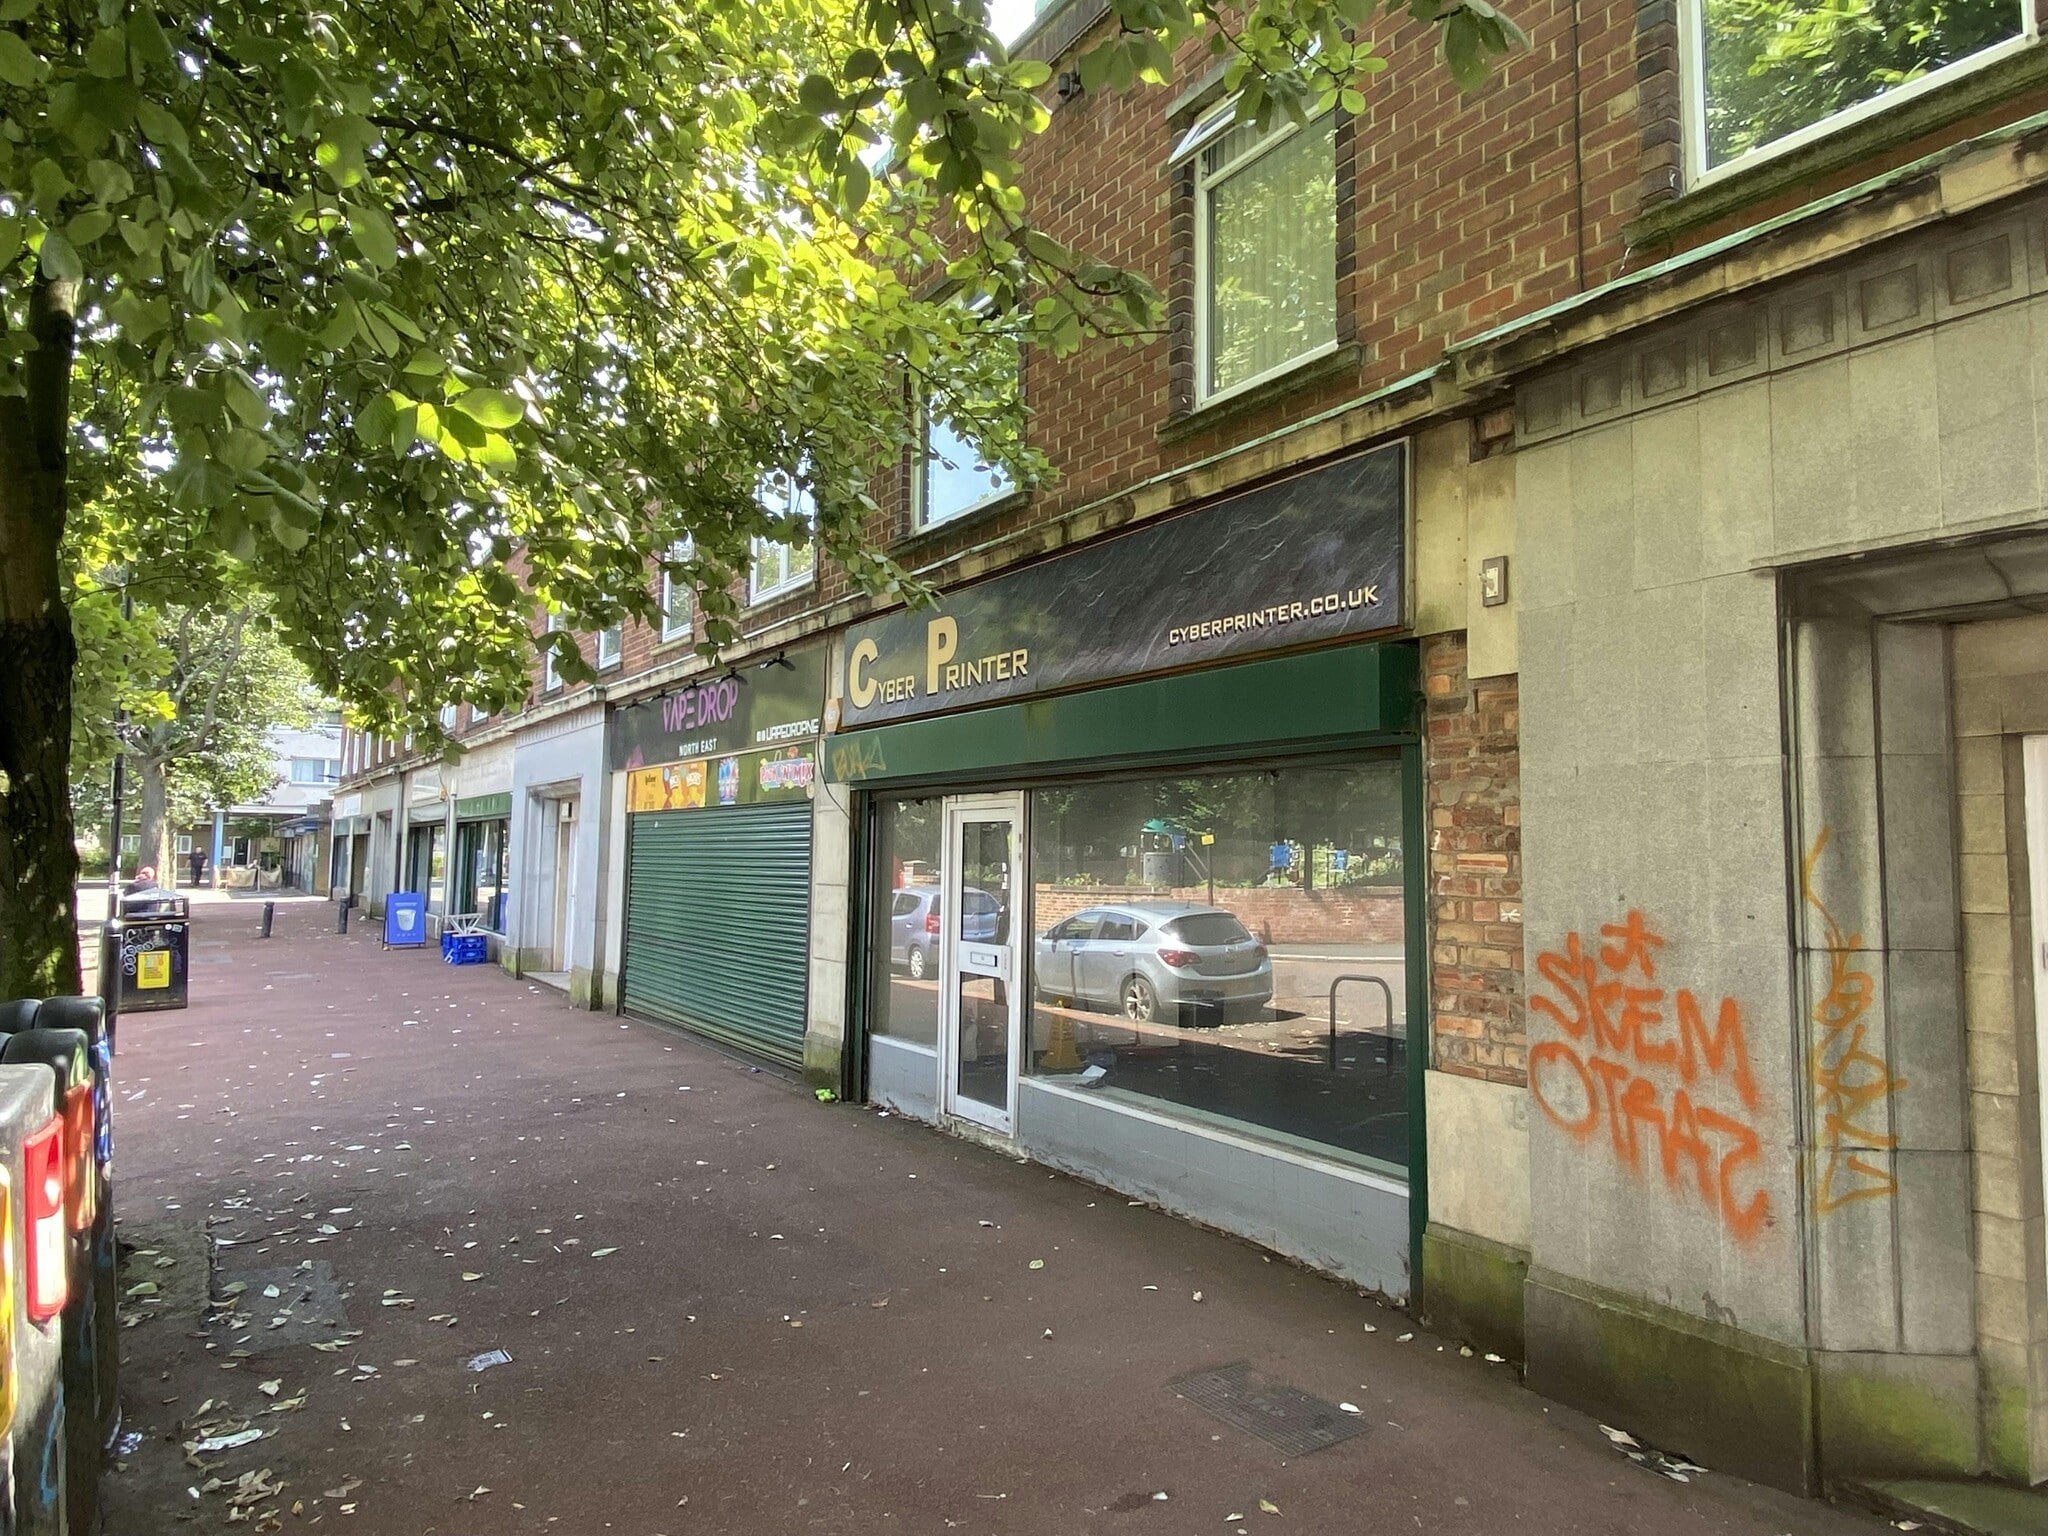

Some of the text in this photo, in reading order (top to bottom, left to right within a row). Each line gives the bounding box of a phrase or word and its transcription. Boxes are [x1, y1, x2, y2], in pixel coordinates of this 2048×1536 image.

[1169, 585, 1379, 645] CYBERPRINTER.CO.UK
[663, 678, 739, 732] VAPE DROP
[679, 738, 718, 757] NORTH EAST
